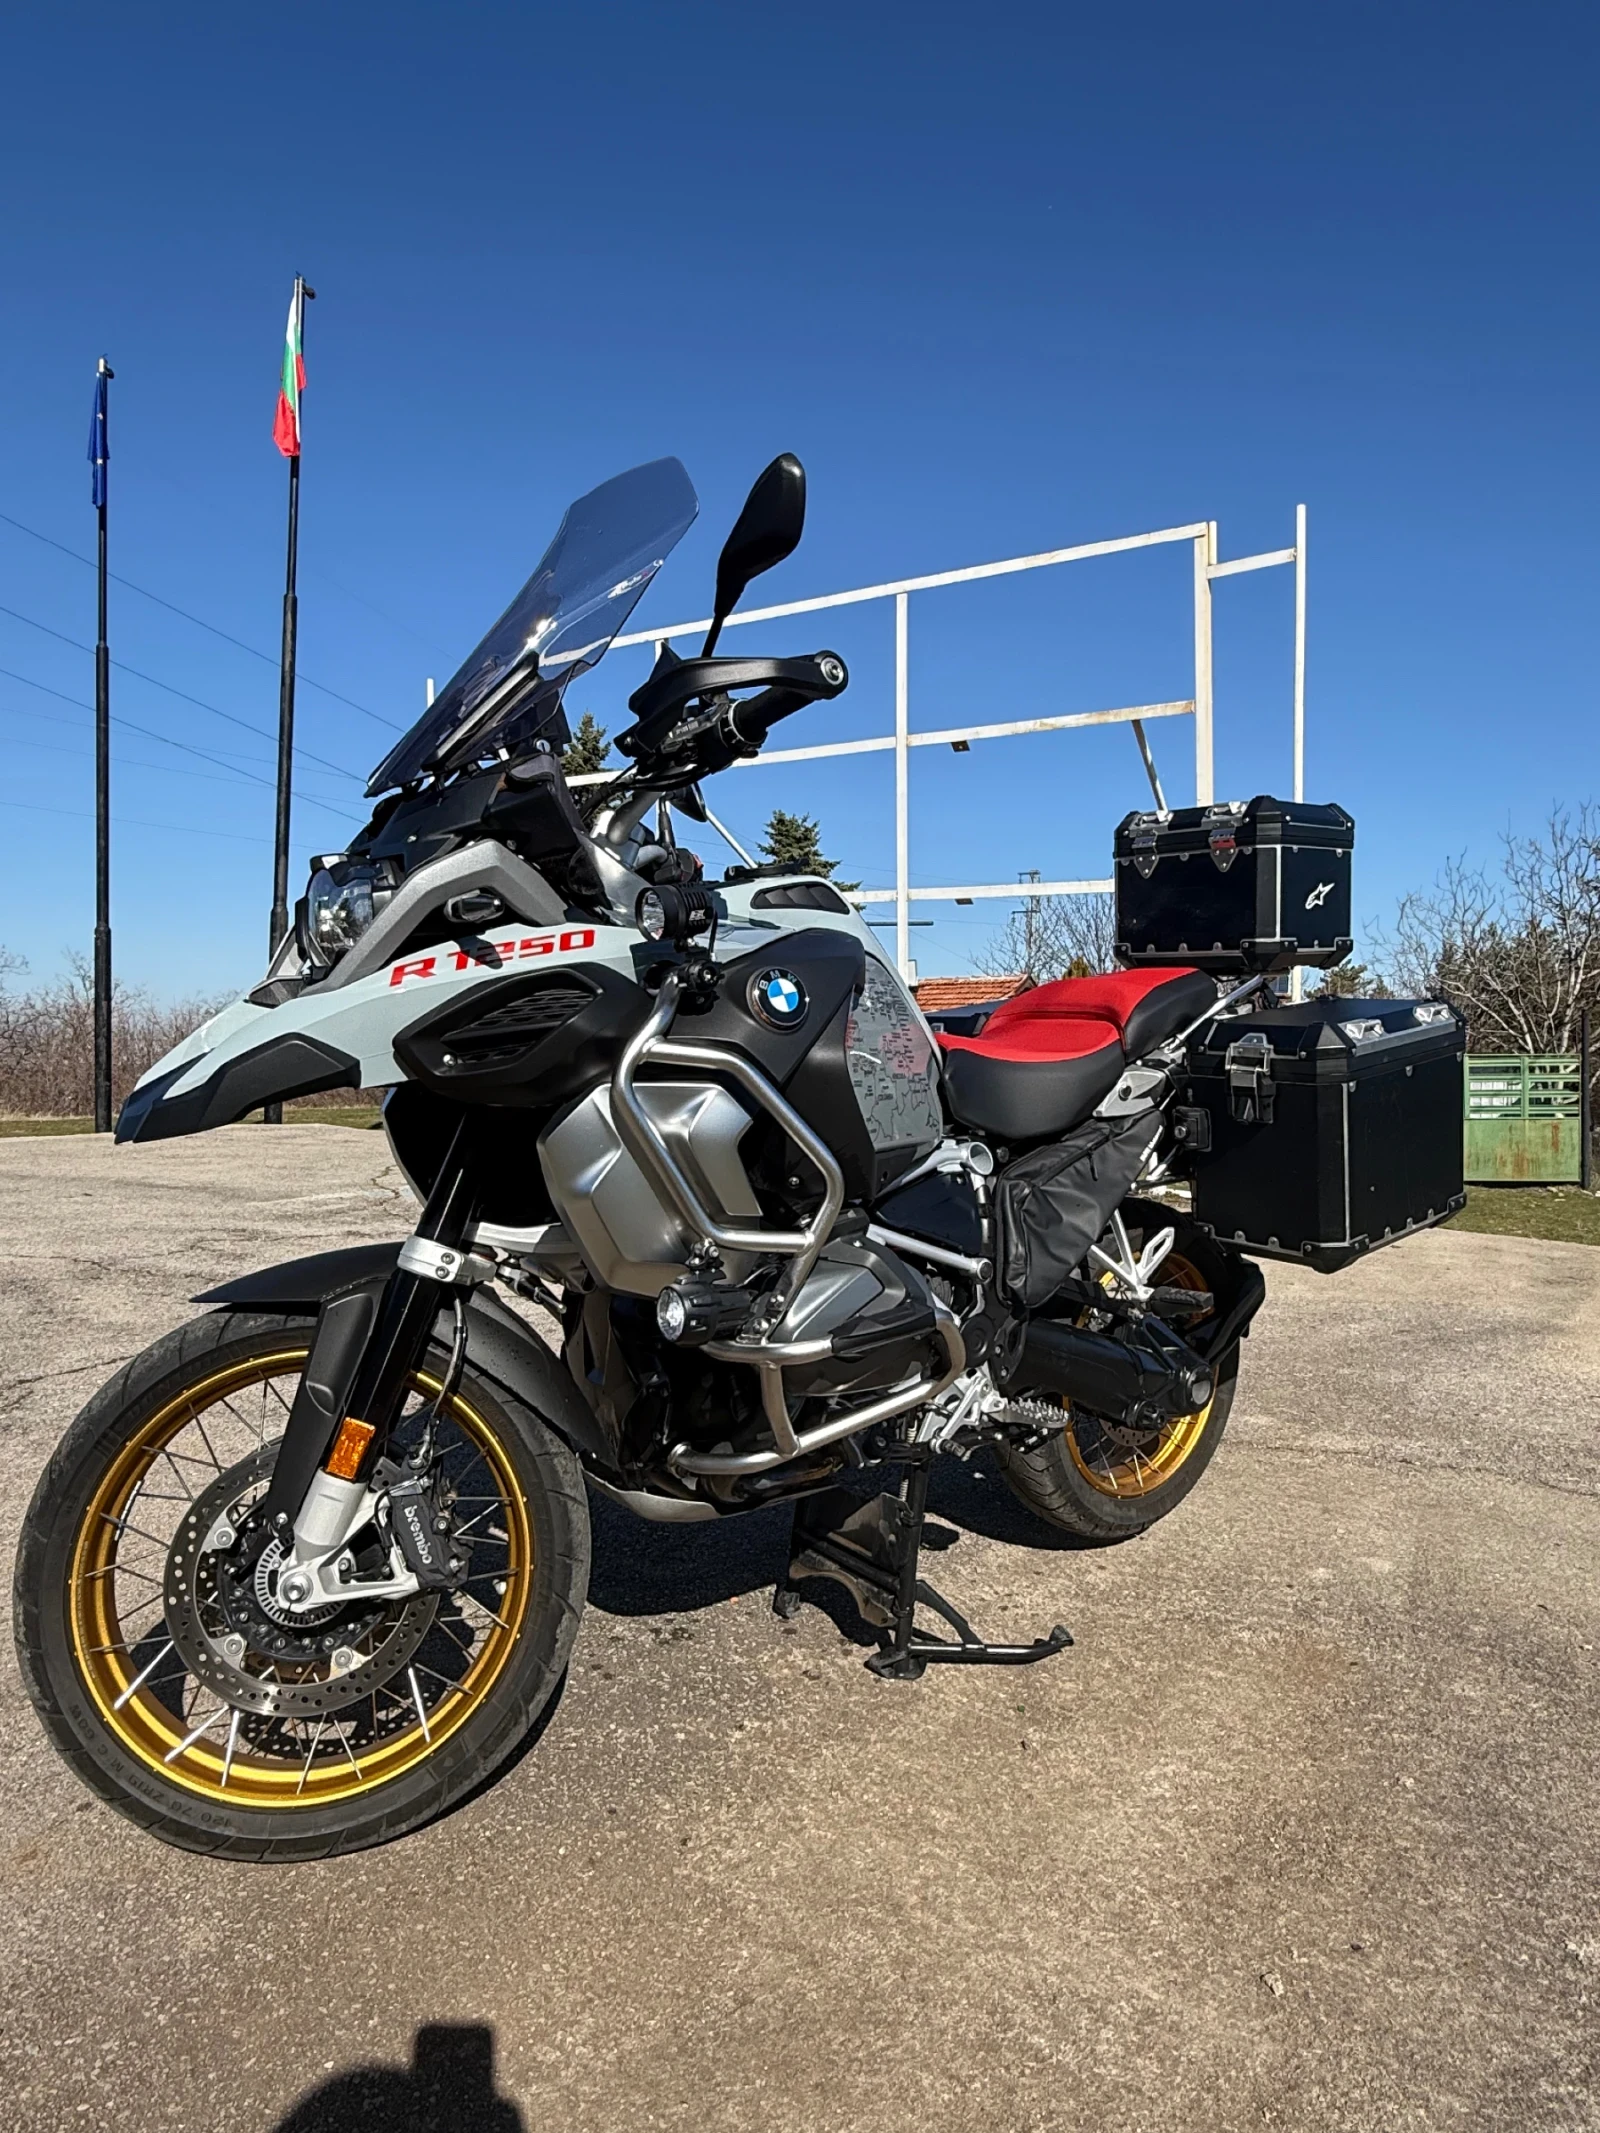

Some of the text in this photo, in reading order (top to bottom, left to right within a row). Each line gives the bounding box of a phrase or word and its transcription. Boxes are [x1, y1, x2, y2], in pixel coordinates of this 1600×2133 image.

[389, 929, 596, 987] R 1250
[759, 969, 798, 991] BMW
[404, 1505, 433, 1564] brembo
